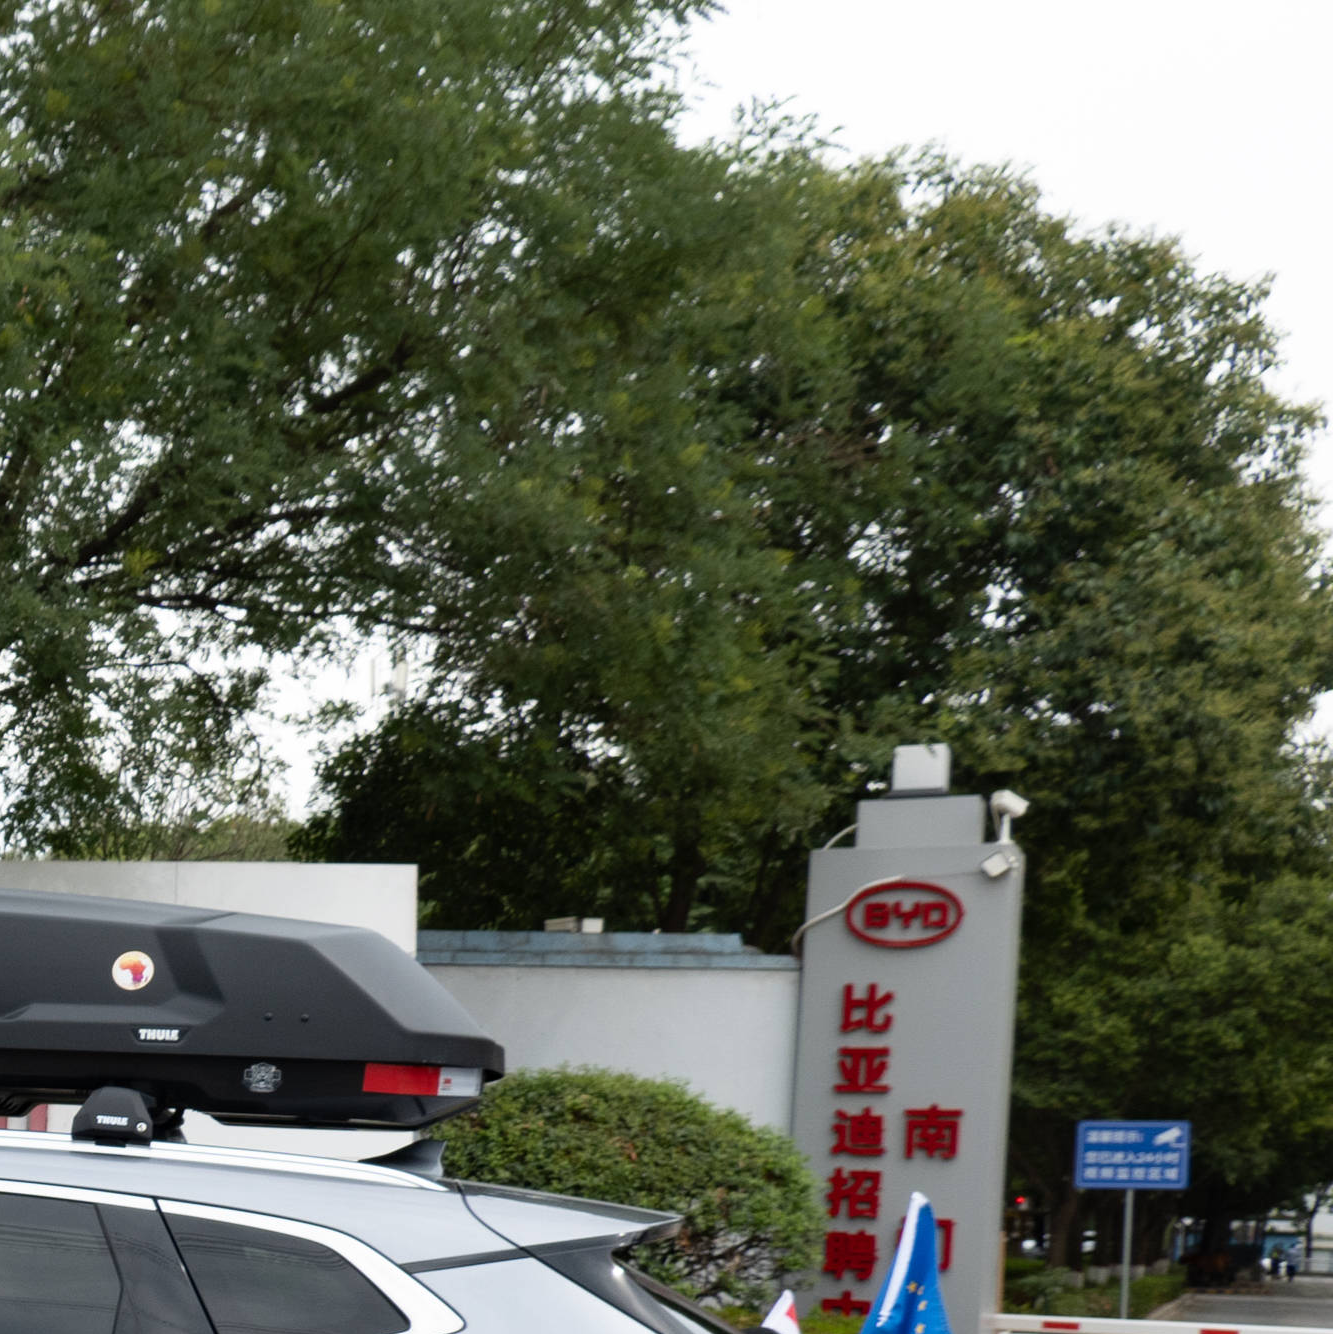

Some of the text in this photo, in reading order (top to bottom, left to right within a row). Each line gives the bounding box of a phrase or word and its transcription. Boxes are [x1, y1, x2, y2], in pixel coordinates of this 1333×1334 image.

[864, 901, 949, 929] BYD
[138, 1028, 180, 1041] THULE
[96, 1115, 130, 1126] THULE
